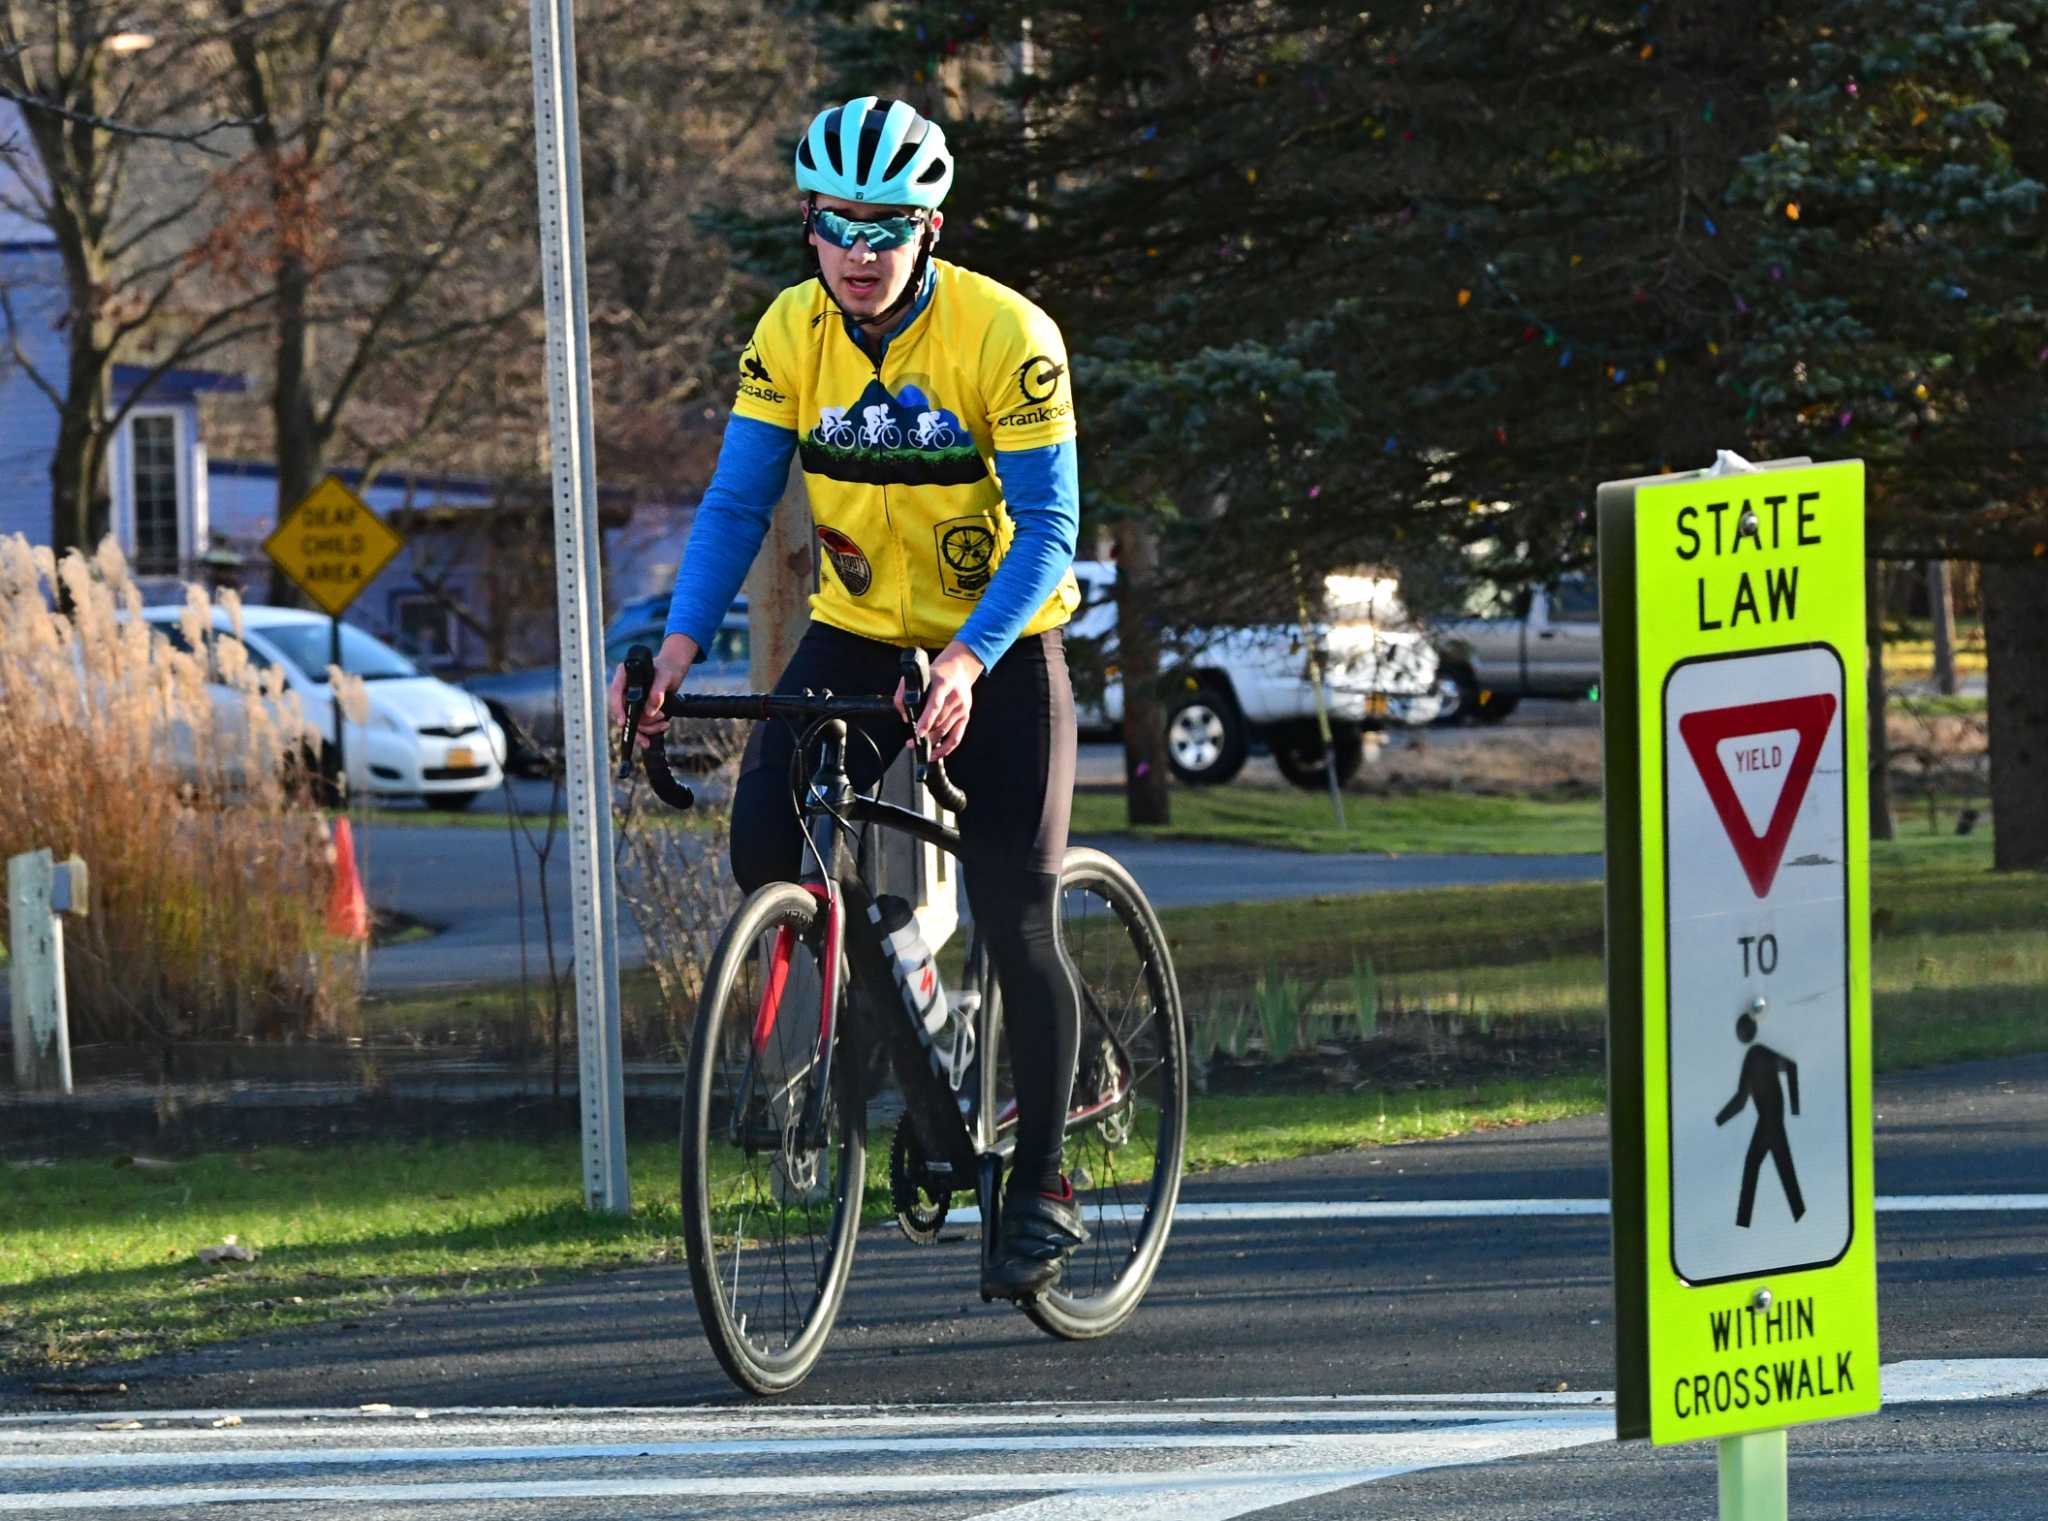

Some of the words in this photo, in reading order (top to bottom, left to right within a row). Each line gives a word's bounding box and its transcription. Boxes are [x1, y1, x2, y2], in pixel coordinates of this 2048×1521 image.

[303, 507, 358, 527] DEAF
[1676, 491, 1822, 561] STATE
[301, 534, 365, 557] CHILD
[304, 561, 363, 582] AREA
[1698, 566, 1799, 631] LAW
[1735, 745, 1782, 773] YIELD
[1737, 933, 1778, 978] TO
[1710, 1296, 1814, 1352] WITHIN
[1674, 1351, 1854, 1418] CROSSWALK
